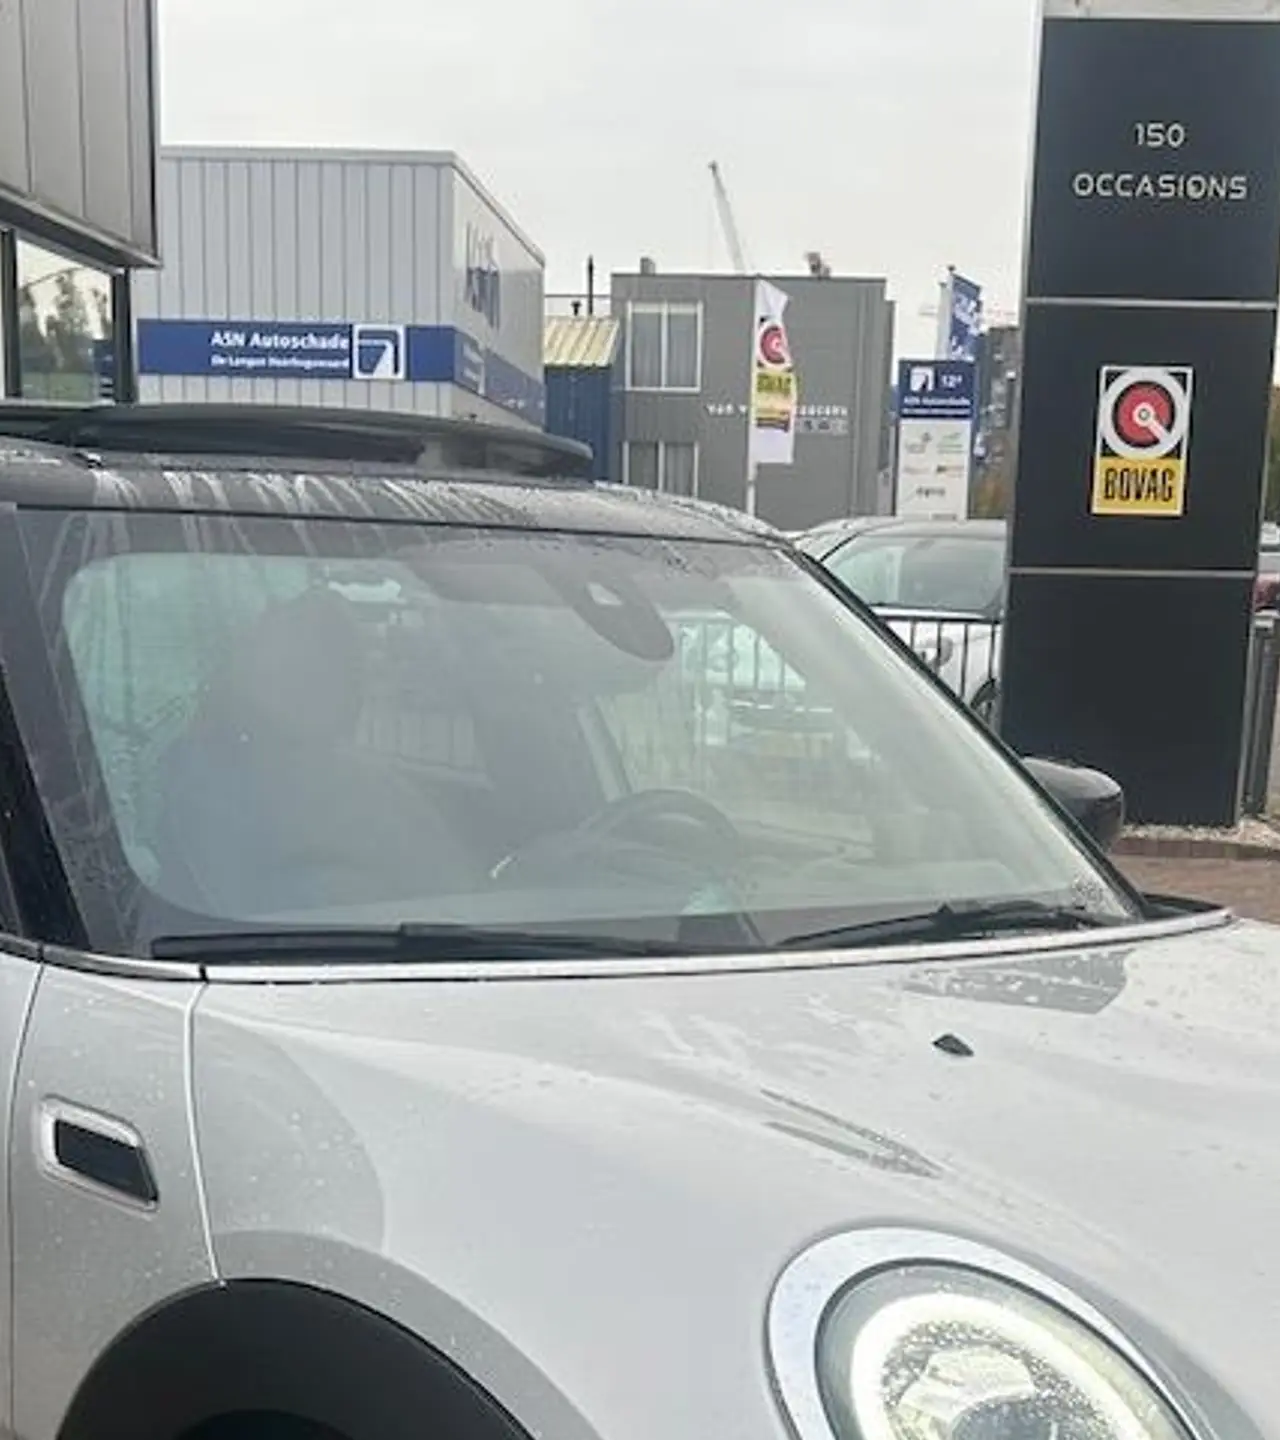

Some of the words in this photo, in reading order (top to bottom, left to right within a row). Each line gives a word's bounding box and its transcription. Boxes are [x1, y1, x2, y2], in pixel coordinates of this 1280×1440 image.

[1133, 123, 1186, 148] 150
[1073, 174, 1248, 200] OCCASIONS
[210, 331, 245, 346] ASN
[249, 332, 349, 349] Autoschade
[1104, 467, 1177, 502] BOVAG
